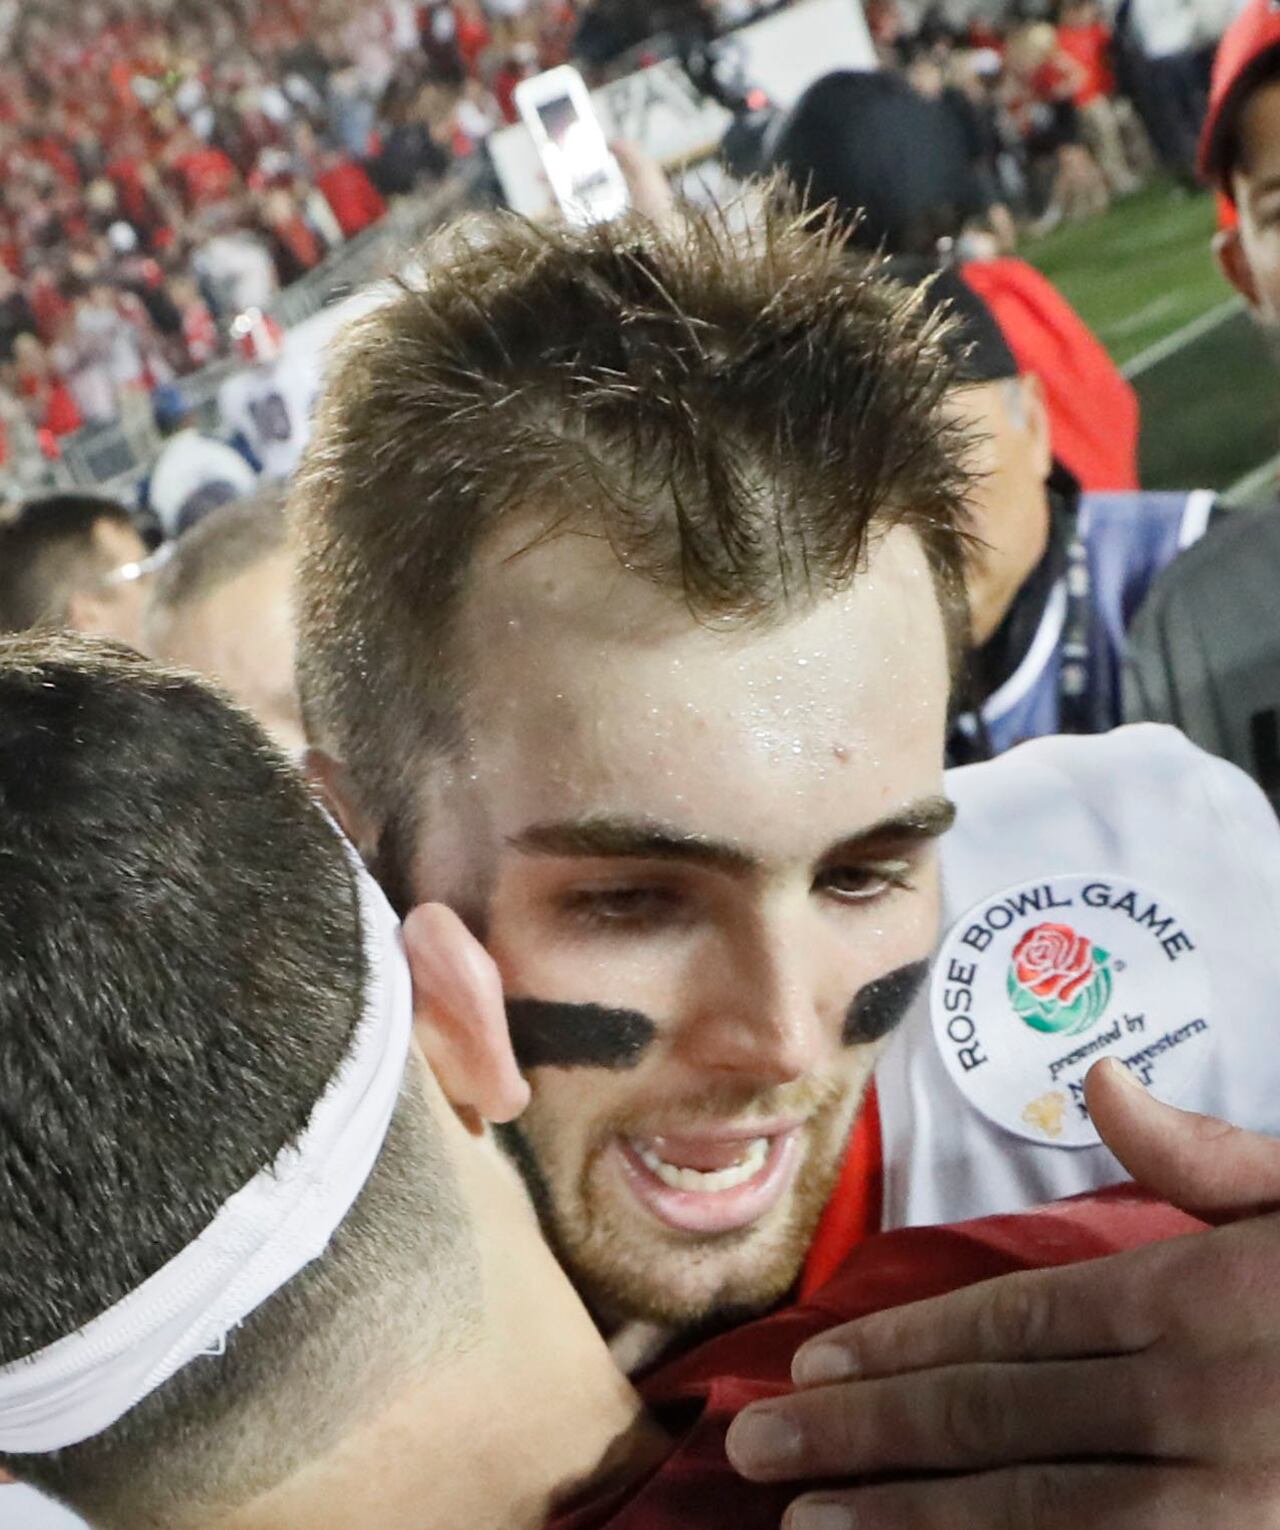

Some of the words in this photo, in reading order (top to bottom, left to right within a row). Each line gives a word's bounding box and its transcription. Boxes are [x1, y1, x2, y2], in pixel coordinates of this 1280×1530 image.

[961, 884, 1073, 953] BOWL
[1081, 882, 1196, 962] GAME
[944, 957, 988, 1073] ROSE
[1048, 1020, 1121, 1082] presented
[1123, 1012, 1146, 1034] by
